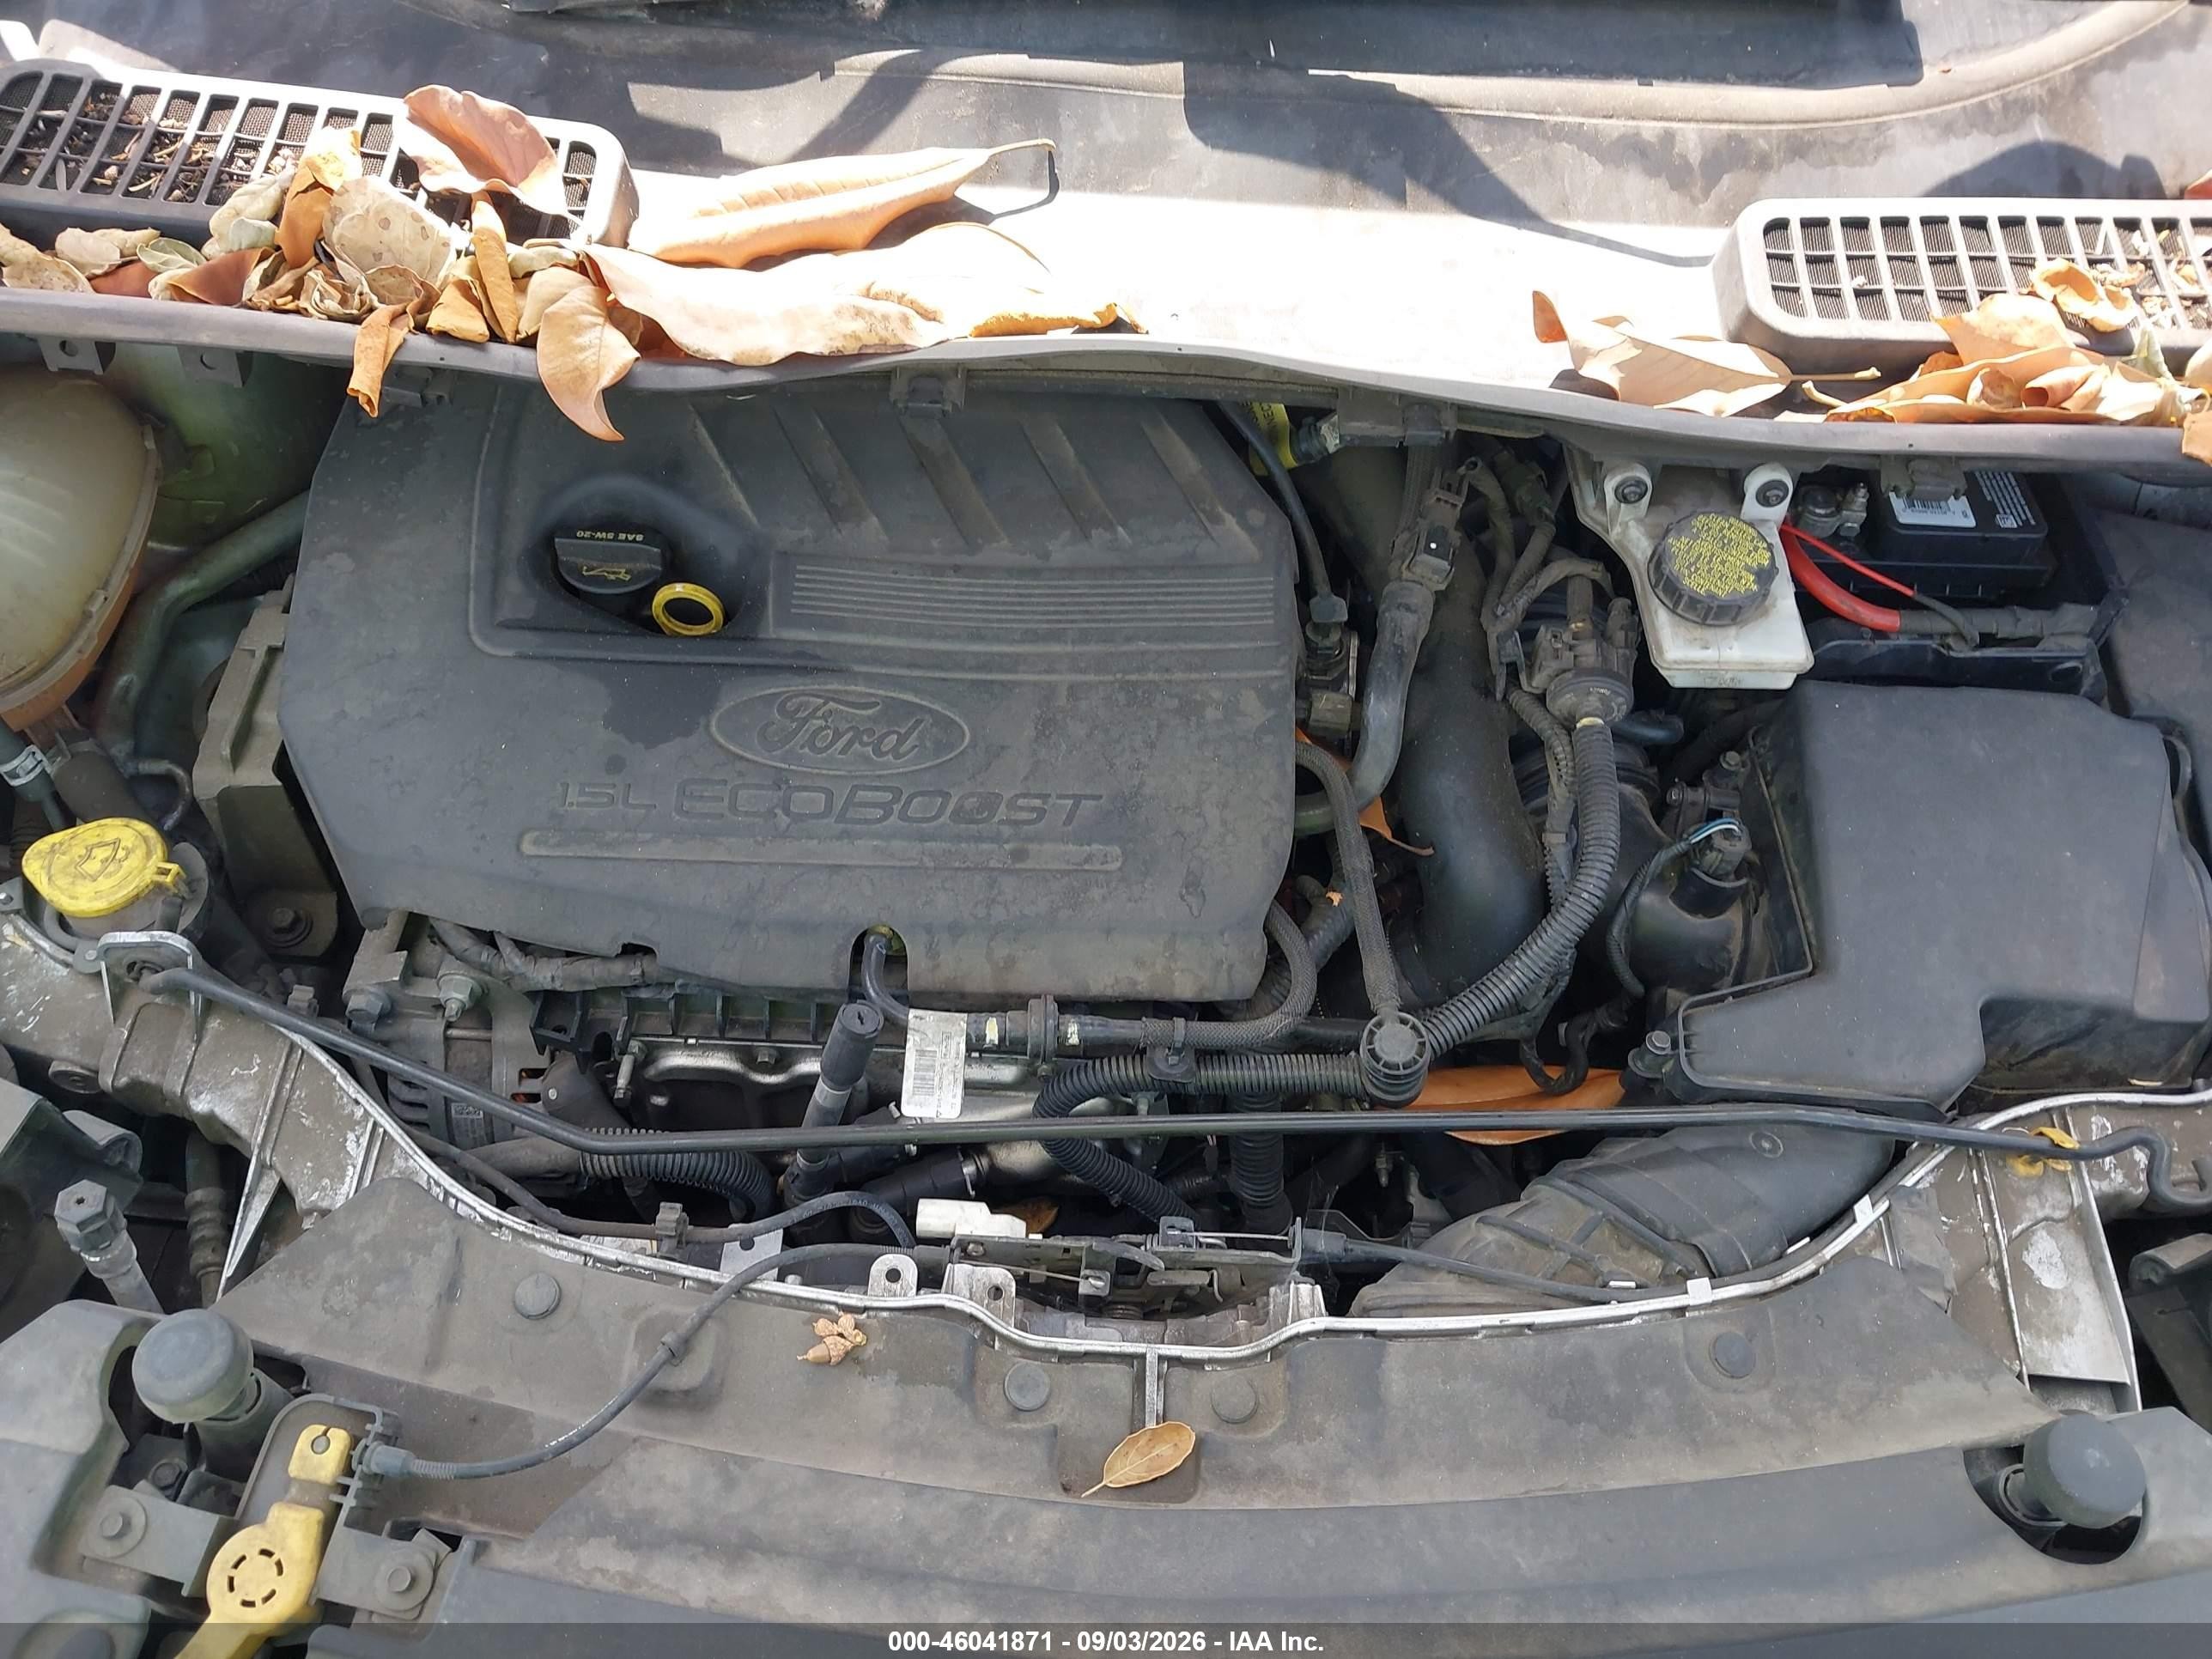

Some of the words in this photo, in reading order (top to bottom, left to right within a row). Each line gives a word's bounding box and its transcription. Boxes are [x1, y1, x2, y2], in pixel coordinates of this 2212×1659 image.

[576, 530, 616, 539] 5W-20
[617, 532, 644, 542] SAE
[757, 691, 921, 761] Ford
[558, 781, 658, 811] 1.5L
